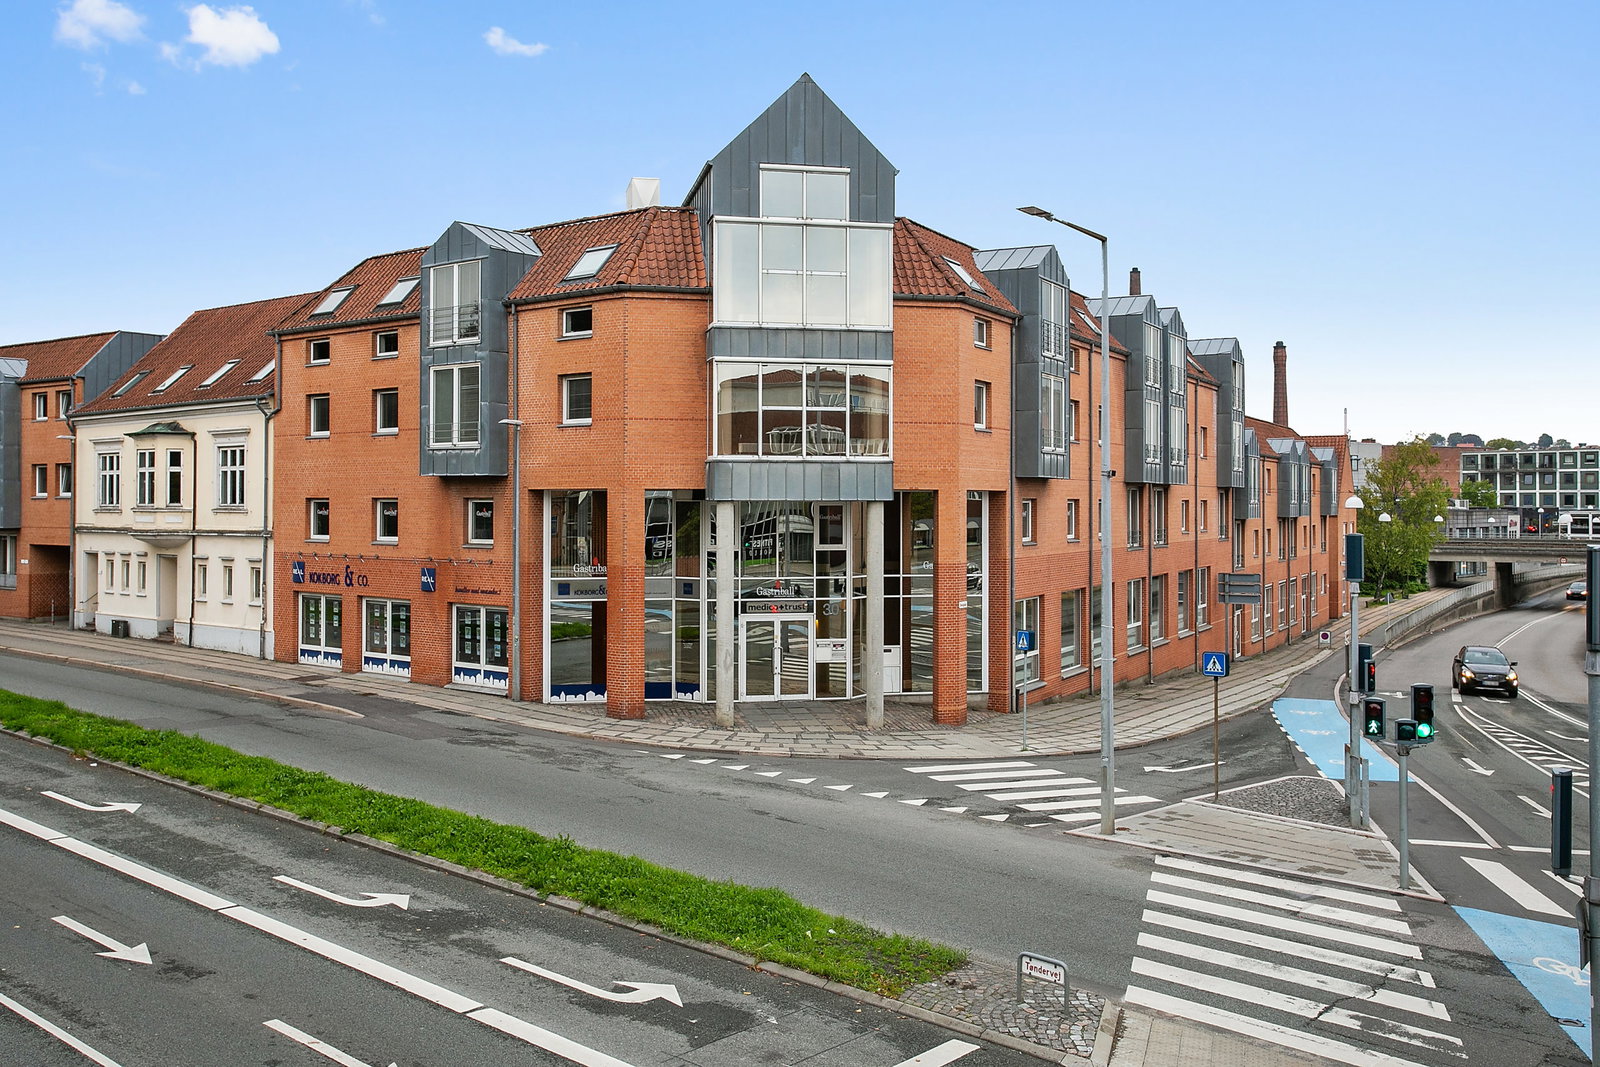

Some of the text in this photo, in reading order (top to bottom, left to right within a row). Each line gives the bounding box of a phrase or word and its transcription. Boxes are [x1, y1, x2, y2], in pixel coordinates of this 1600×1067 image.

[573, 563, 607, 573] Gastriba
[309, 565, 370, 587] KOKBORG & CO.
[822, 603, 840, 616] 30
